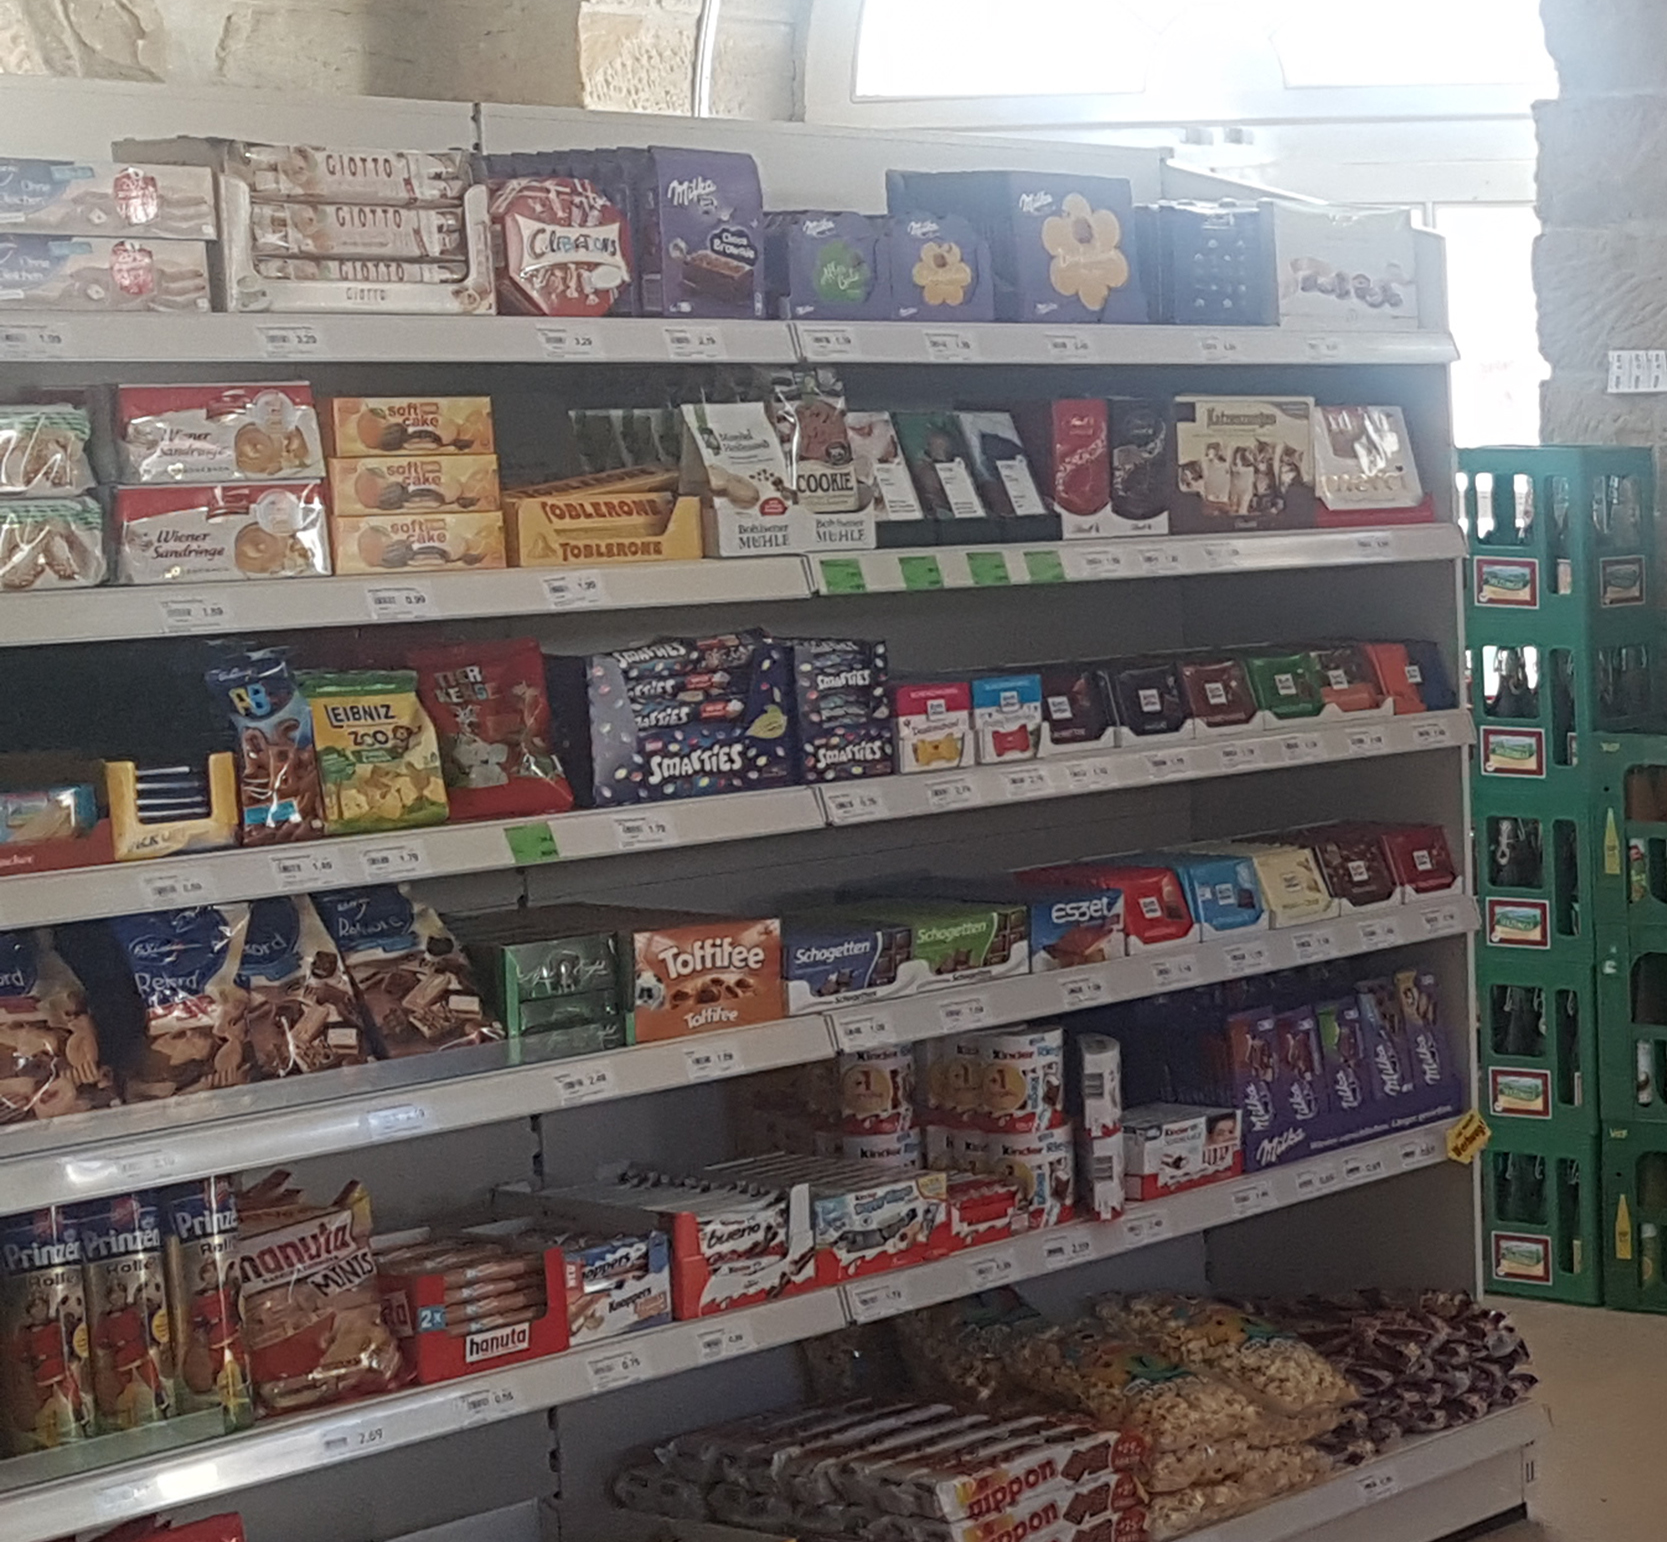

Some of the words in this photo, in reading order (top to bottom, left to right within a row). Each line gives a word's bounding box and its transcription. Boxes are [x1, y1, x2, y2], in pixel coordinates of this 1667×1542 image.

[326, 154, 393, 177] GIOTTO
[668, 176, 717, 206] Milka
[335, 205, 401, 228] GIOTTO
[387, 402, 420, 418] soft
[402, 412, 440, 428] cake
[386, 460, 421, 477] soft
[401, 473, 442, 487] cake
[796, 471, 854, 495] COOKIE
[156, 529, 211, 545] Wiener
[390, 518, 424, 534] soft
[405, 530, 447, 545] cake
[152, 544, 226, 560] Sandringe
[558, 539, 664, 562] TOBLERONE
[816, 668, 872, 690] SMARTIES
[323, 703, 397, 729] LEIBNIZ
[649, 742, 744, 785] SMARTIES
[816, 740, 883, 769] SMARTIES
[917, 920, 988, 943] Schogetten
[657, 937, 766, 981] Toffifee
[795, 938, 872, 966] Schogetten
[683, 1006, 739, 1031] Toffifee
[1256, 1126, 1307, 1166] Milka
[705, 1220, 762, 1251] bueno
[238, 1221, 352, 1284] hanuta
[307, 1251, 375, 1297] MINIS
[419, 1309, 444, 1329] 2x
[468, 1326, 528, 1358] hanuta
[968, 1457, 1057, 1522] nippon
